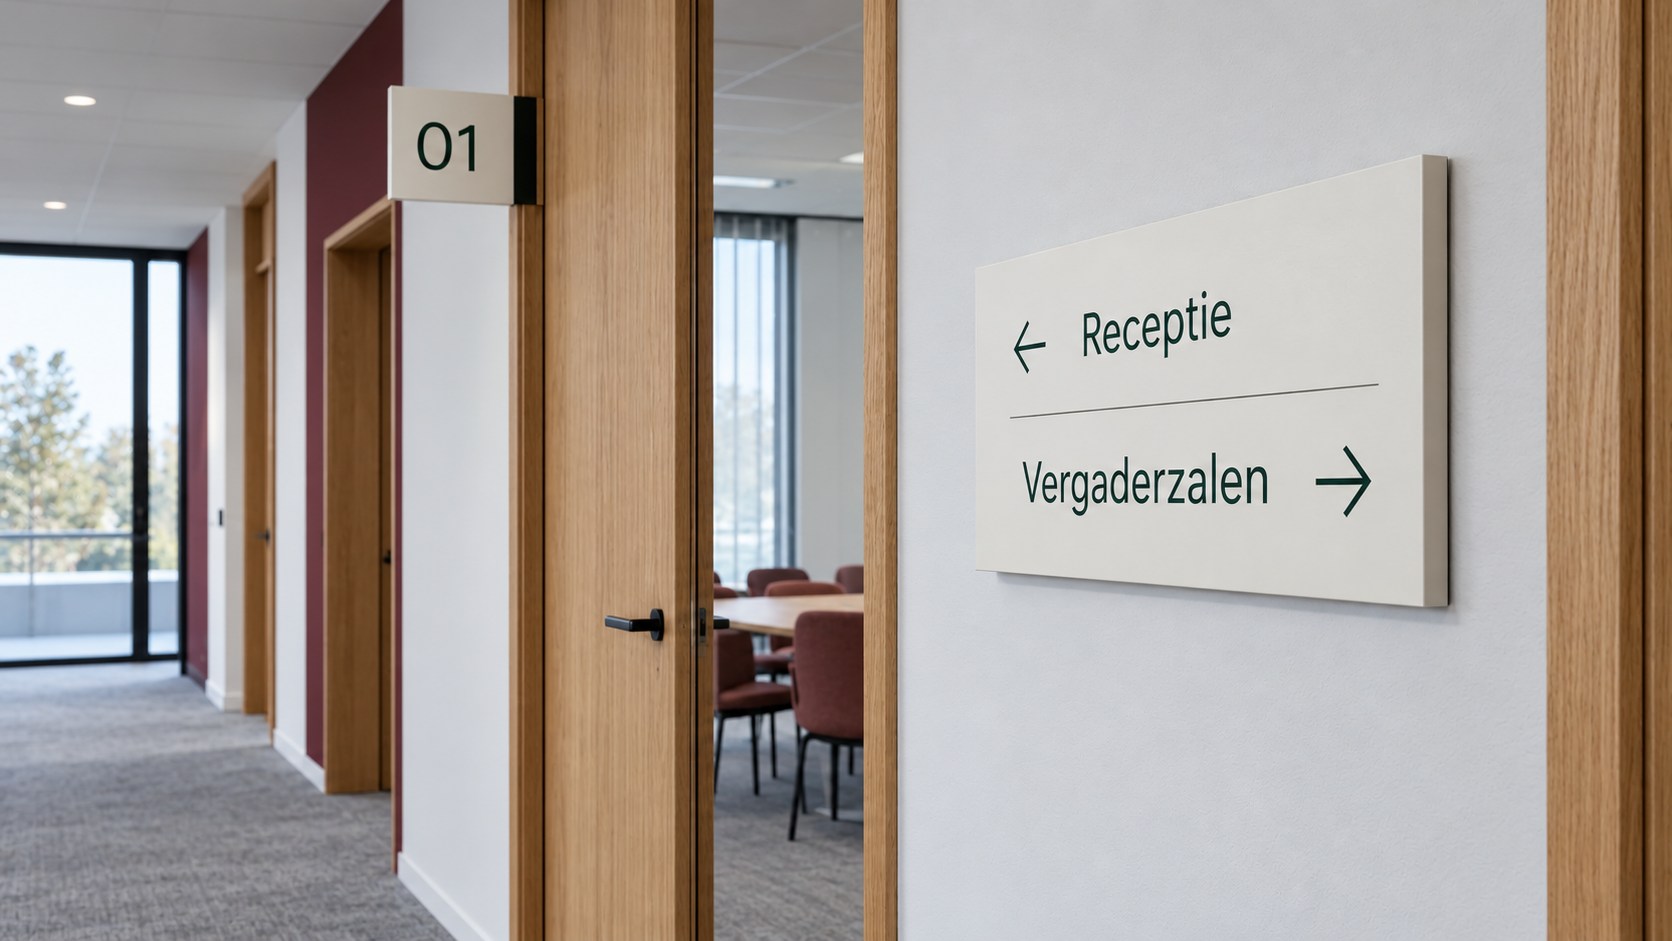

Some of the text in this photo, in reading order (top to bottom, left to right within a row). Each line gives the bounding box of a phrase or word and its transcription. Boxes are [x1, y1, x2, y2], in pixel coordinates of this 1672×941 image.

[416, 121, 476, 172] 01
[1083, 291, 1232, 359] Receptie
[1022, 452, 1269, 517] Vergaderzalen
